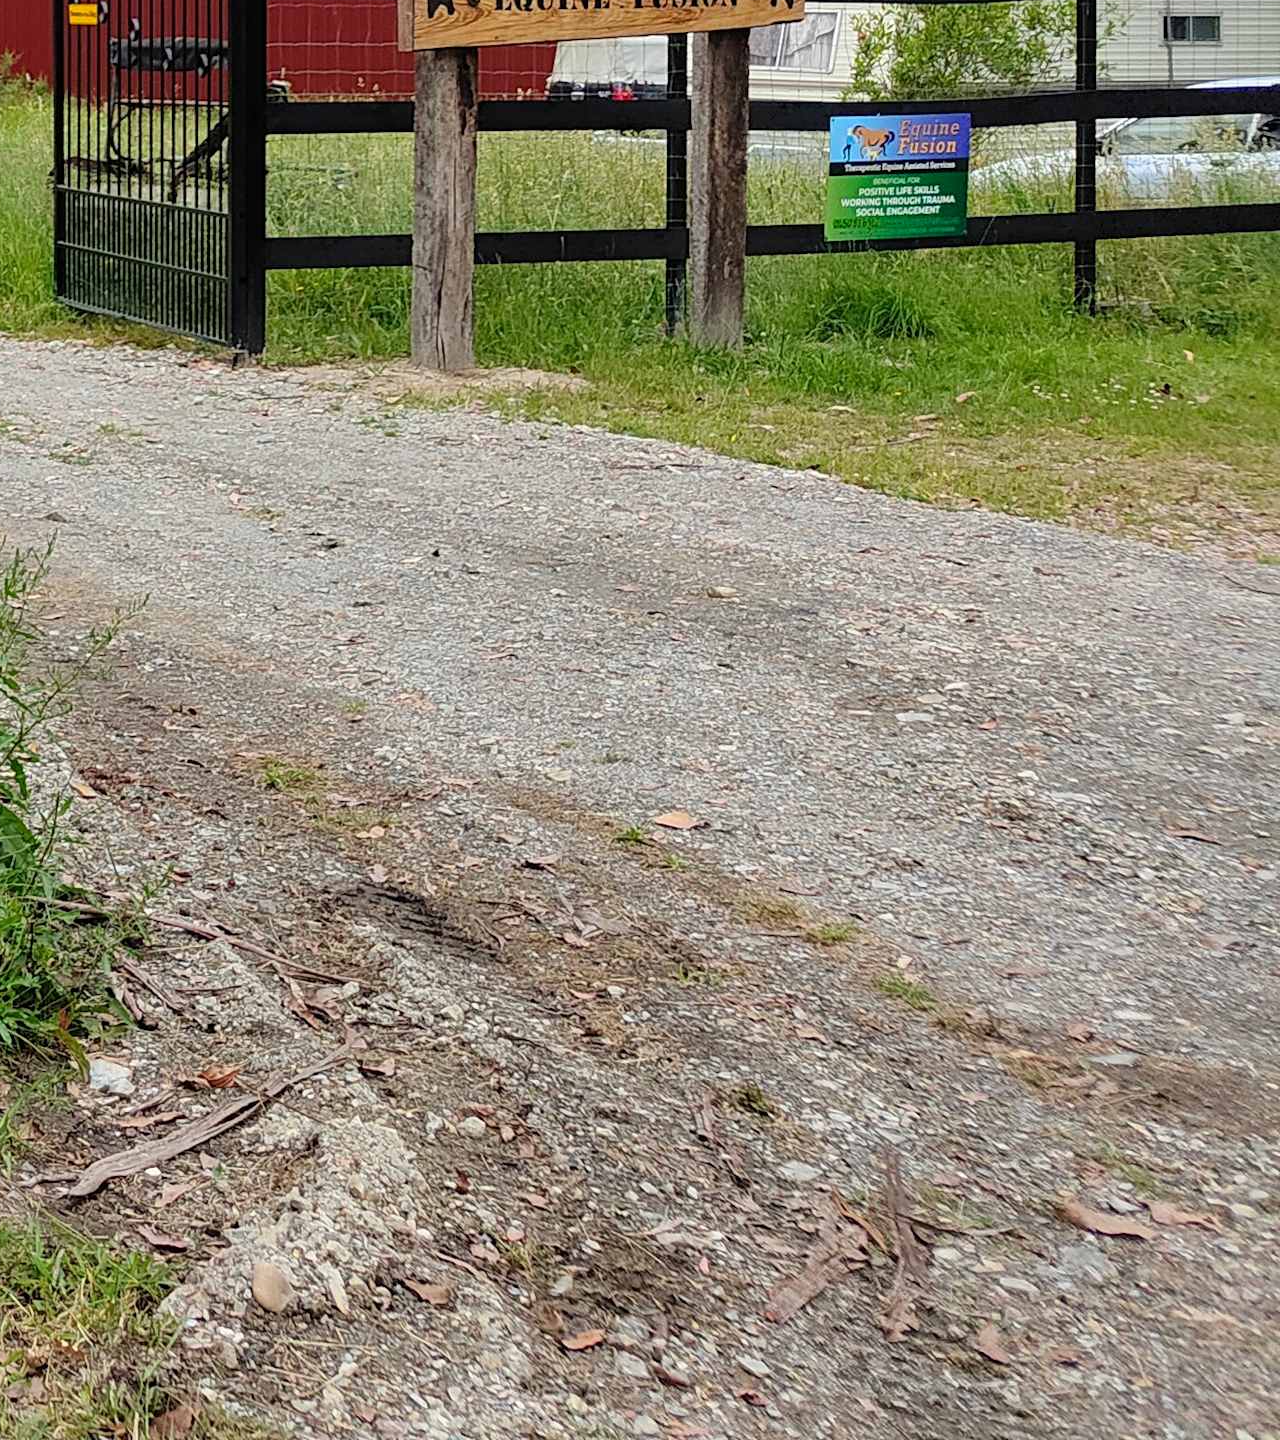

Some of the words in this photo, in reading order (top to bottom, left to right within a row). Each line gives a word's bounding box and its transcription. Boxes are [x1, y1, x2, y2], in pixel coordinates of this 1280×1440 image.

[900, 119, 960, 138] Equine
[896, 137, 957, 156] Fusion
[906, 176, 921, 184] FOR
[858, 187, 895, 196] POSITIVE
[896, 186, 913, 195] LIFE
[914, 185, 940, 194] SKILLS
[840, 197, 881, 207] WORKING
[882, 196, 920, 206] THROUGH
[922, 195, 956, 205] TRAUMA
[855, 208, 885, 217] SOCIAL
[886, 206, 941, 216] ENGAGEMENT
